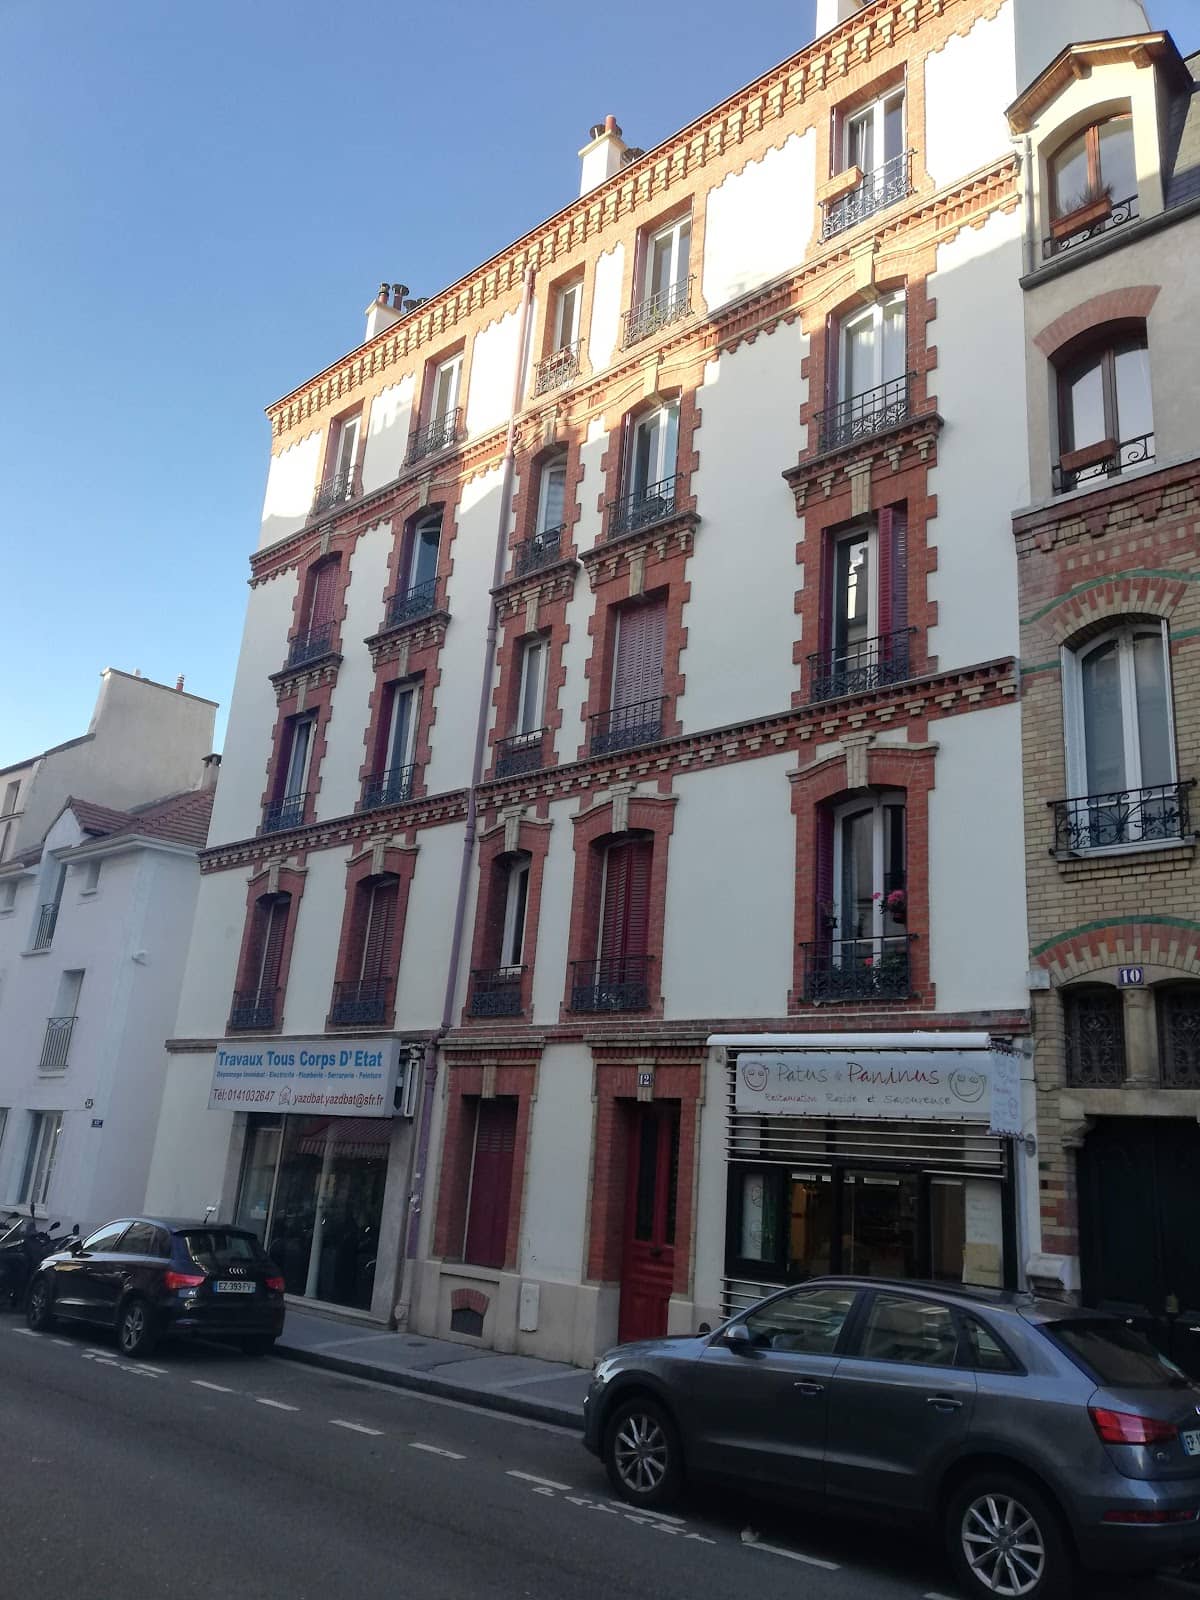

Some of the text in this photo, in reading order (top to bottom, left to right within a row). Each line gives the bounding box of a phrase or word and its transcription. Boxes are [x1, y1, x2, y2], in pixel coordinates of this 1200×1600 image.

[1122, 968, 1141, 984] 10
[218, 1051, 263, 1067] Travaux
[267, 1050, 295, 1066] Tous
[300, 1050, 336, 1070] Corps
[639, 1074, 650, 1086] 12
[776, 1062, 829, 1083] Patus
[846, 1062, 940, 1086] Paninus
[532, 1486, 717, 1545] PAYANT
